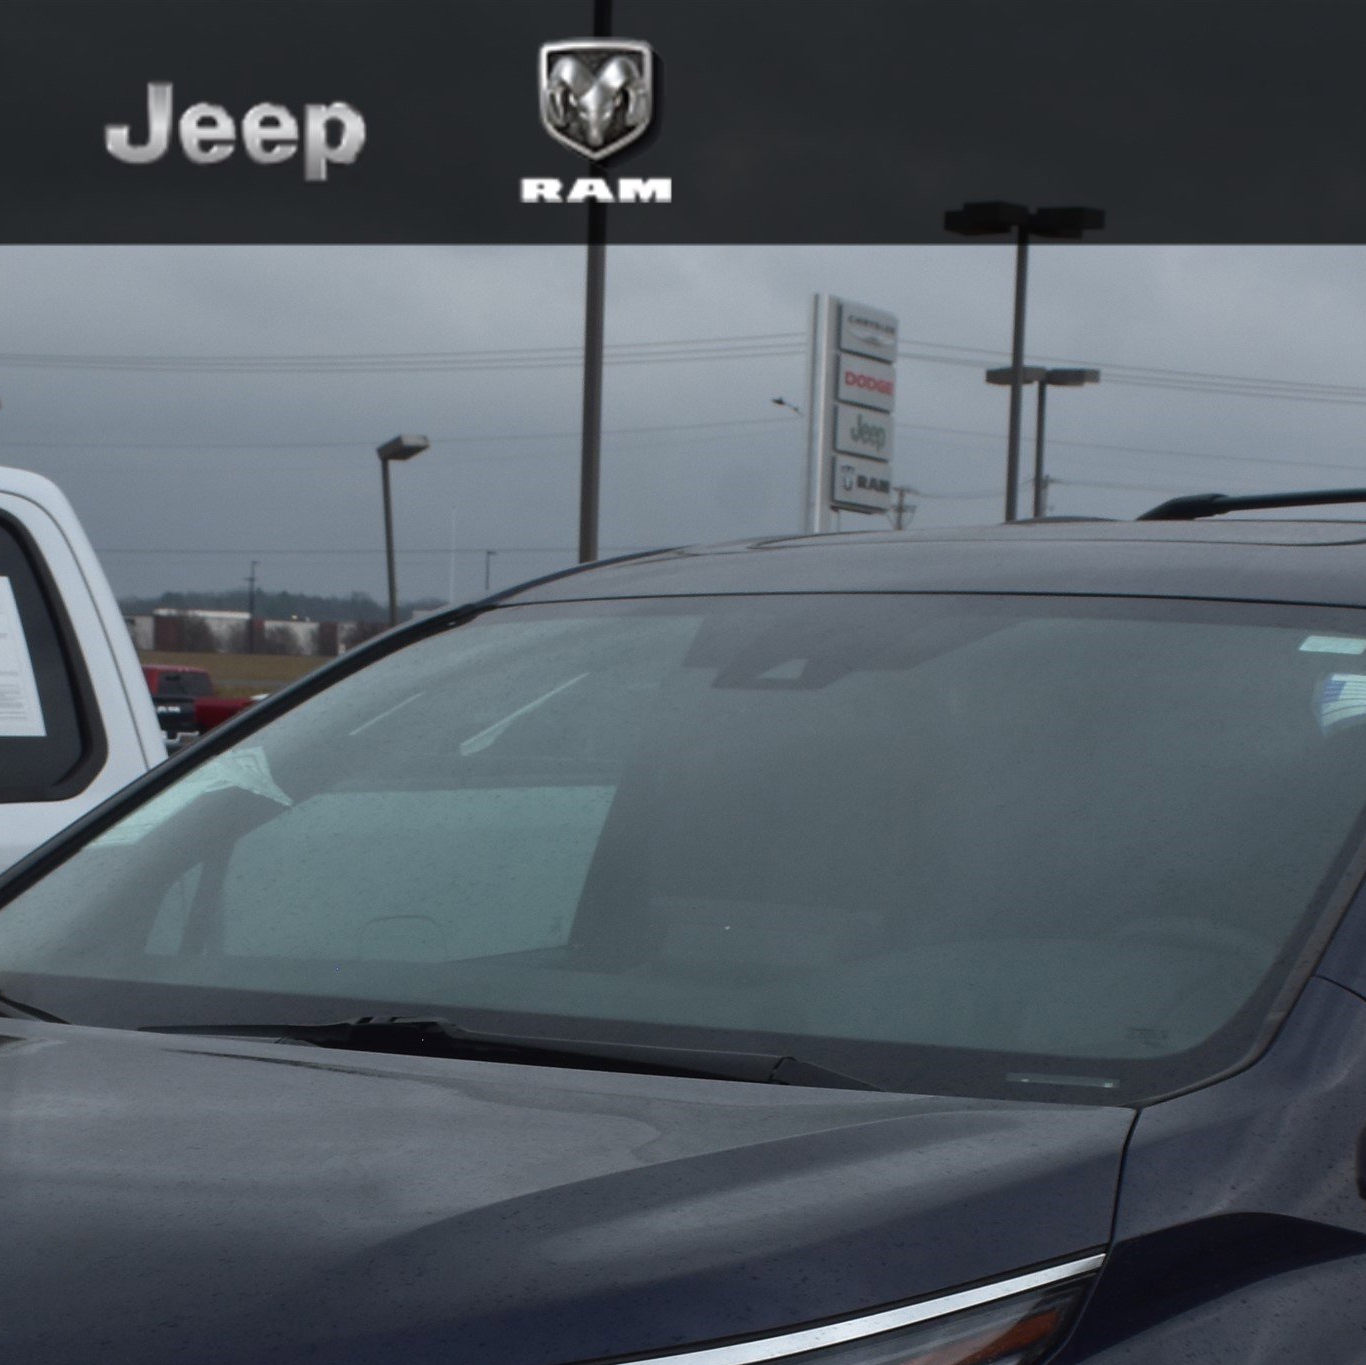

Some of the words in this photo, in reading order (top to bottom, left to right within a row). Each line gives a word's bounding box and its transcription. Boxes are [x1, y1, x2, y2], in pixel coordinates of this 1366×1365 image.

[844, 370, 894, 396] DODGE
[850, 413, 886, 451] Jeep
[857, 474, 890, 495] RAM
